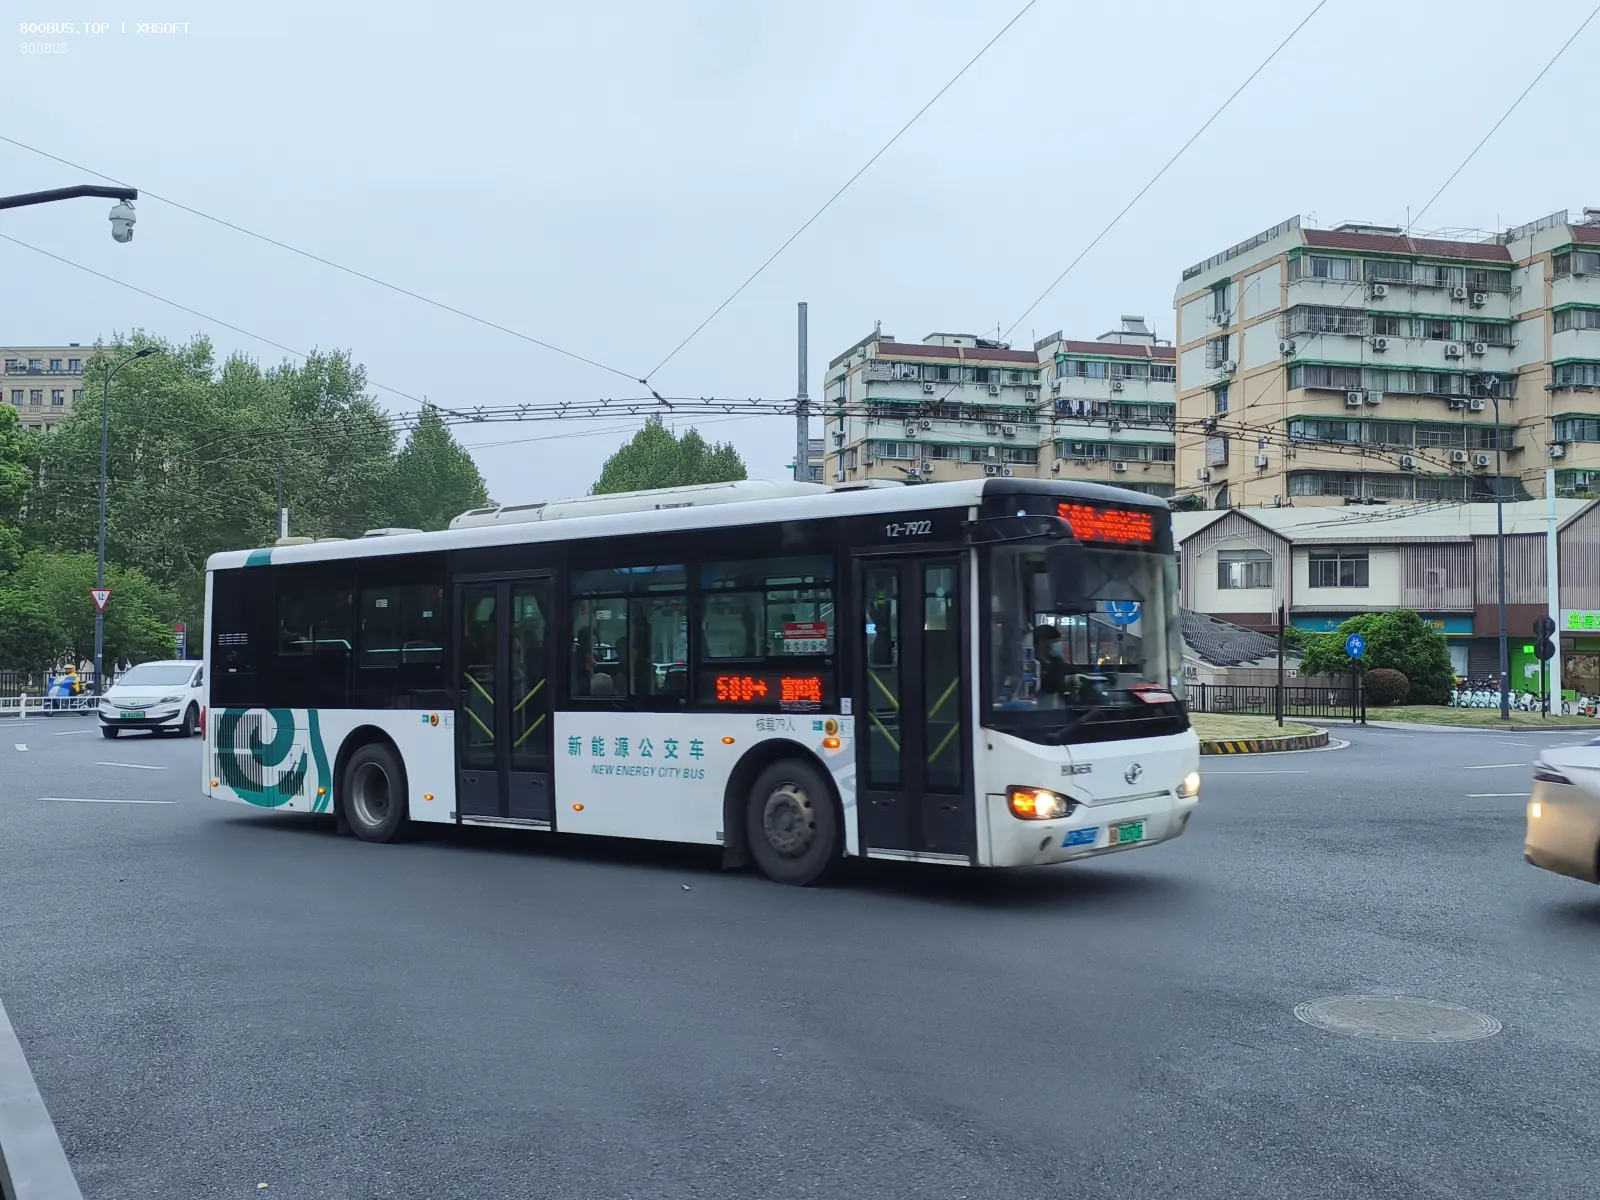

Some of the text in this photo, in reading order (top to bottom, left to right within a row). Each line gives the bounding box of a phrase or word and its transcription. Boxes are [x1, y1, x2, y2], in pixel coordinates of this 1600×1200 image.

[885, 520, 932, 537] 12-7922
[567, 735, 705, 761] 新能源公交车
[591, 764, 705, 780] NEW ENERGY CITY BUS
